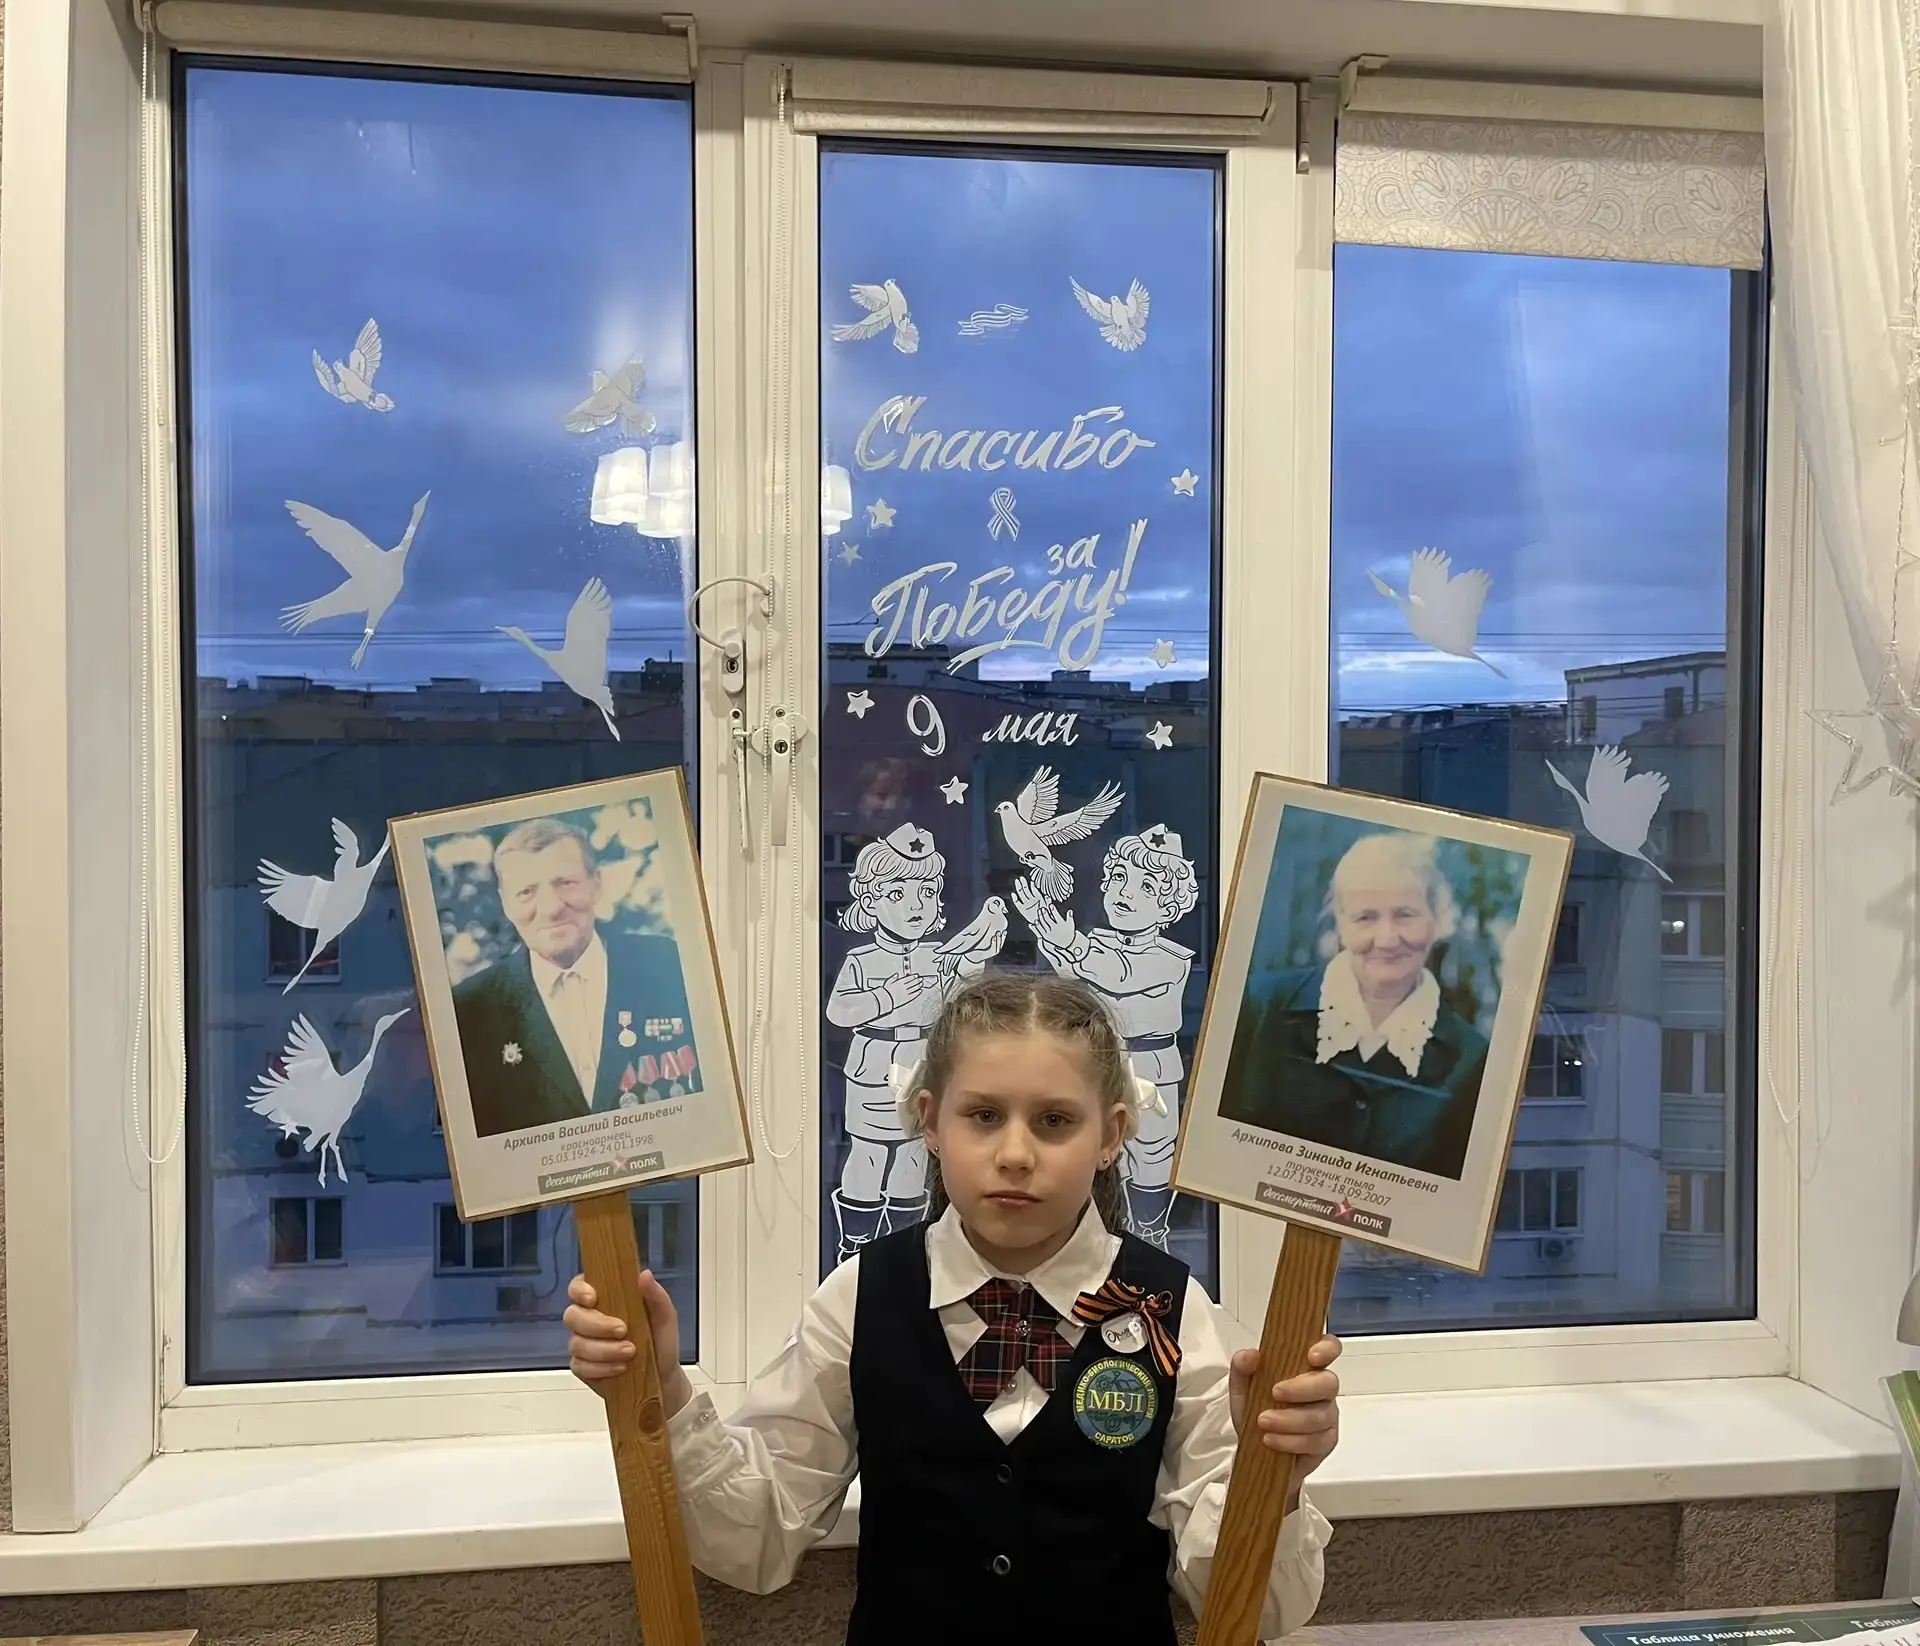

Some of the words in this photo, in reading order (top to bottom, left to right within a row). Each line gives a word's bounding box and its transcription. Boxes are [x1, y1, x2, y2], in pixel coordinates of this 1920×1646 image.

[854, 395, 1157, 472] Спасибо
[1047, 533, 1101, 576] за
[864, 518, 1148, 675] Победу!
[906, 694, 946, 757] 9
[982, 709, 1079, 747] мая
[503, 1131, 555, 1151] Архипов
[559, 1117, 609, 1138] Василий
[613, 1104, 683, 1127] Васильевич
[561, 1130, 631, 1154] красноармеец
[629, 1155, 658, 1170] полк
[1231, 1127, 1293, 1154] Архипова
[1296, 1145, 1352, 1170] Зинаида
[1355, 1161, 1439, 1193] Игнатьевна
[1267, 1165, 1325, 1188] 12.07.1924
[1285, 1160, 1341, 1183] труженик
[1343, 1176, 1376, 1192] тыла
[1353, 1213, 1384, 1230] полк
[1088, 1389, 1144, 1413] МБЛ
[1094, 1432, 1134, 1445] САРАТОВ
[1626, 1633, 1701, 1646] Таблица
[1702, 1627, 1796, 1643] умножения
